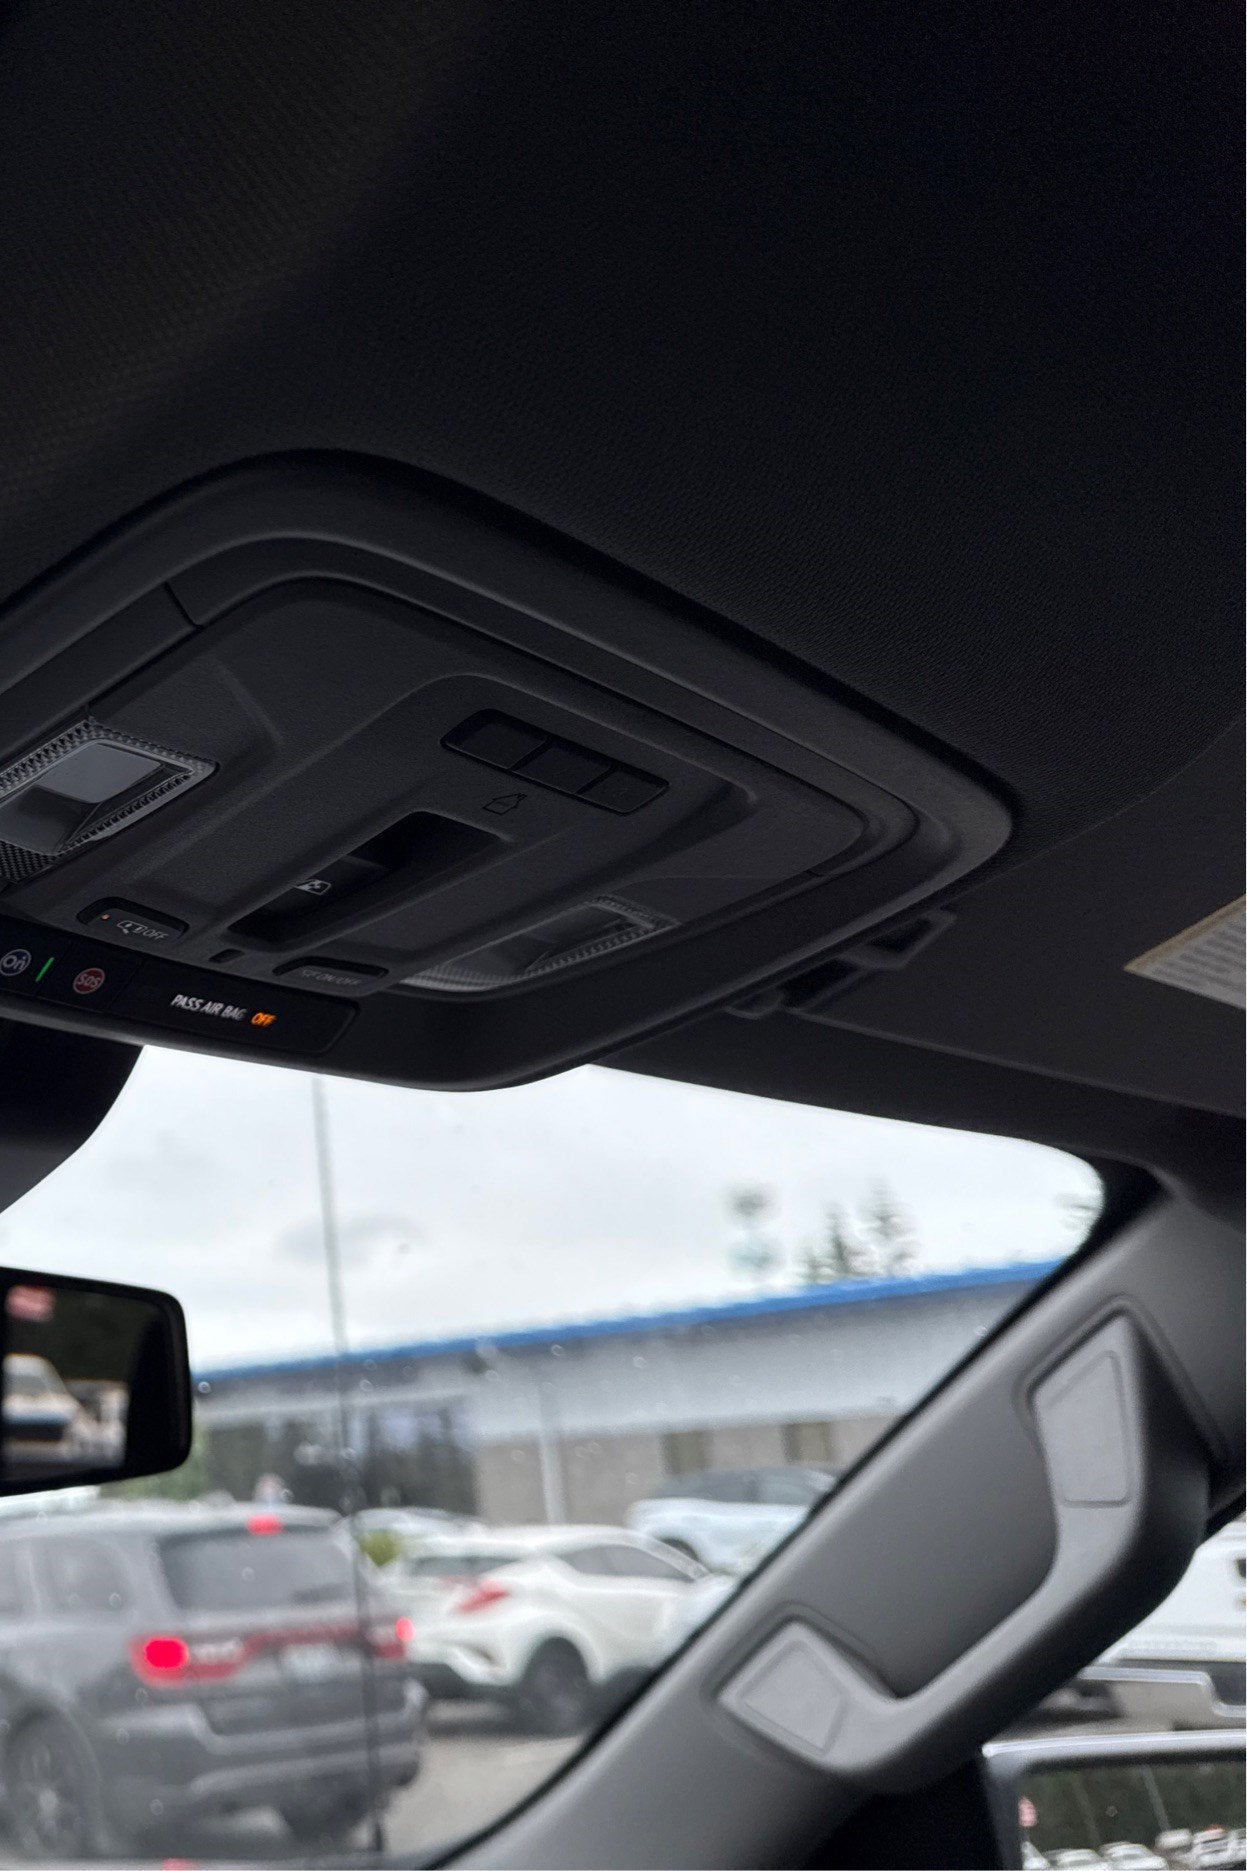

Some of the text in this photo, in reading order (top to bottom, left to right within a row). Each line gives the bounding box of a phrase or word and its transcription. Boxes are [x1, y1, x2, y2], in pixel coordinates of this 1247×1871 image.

[142, 928, 169, 940] OFF
[78, 973, 101, 988] SOS
[170, 994, 277, 1027] PASS AIR BAG OFF
